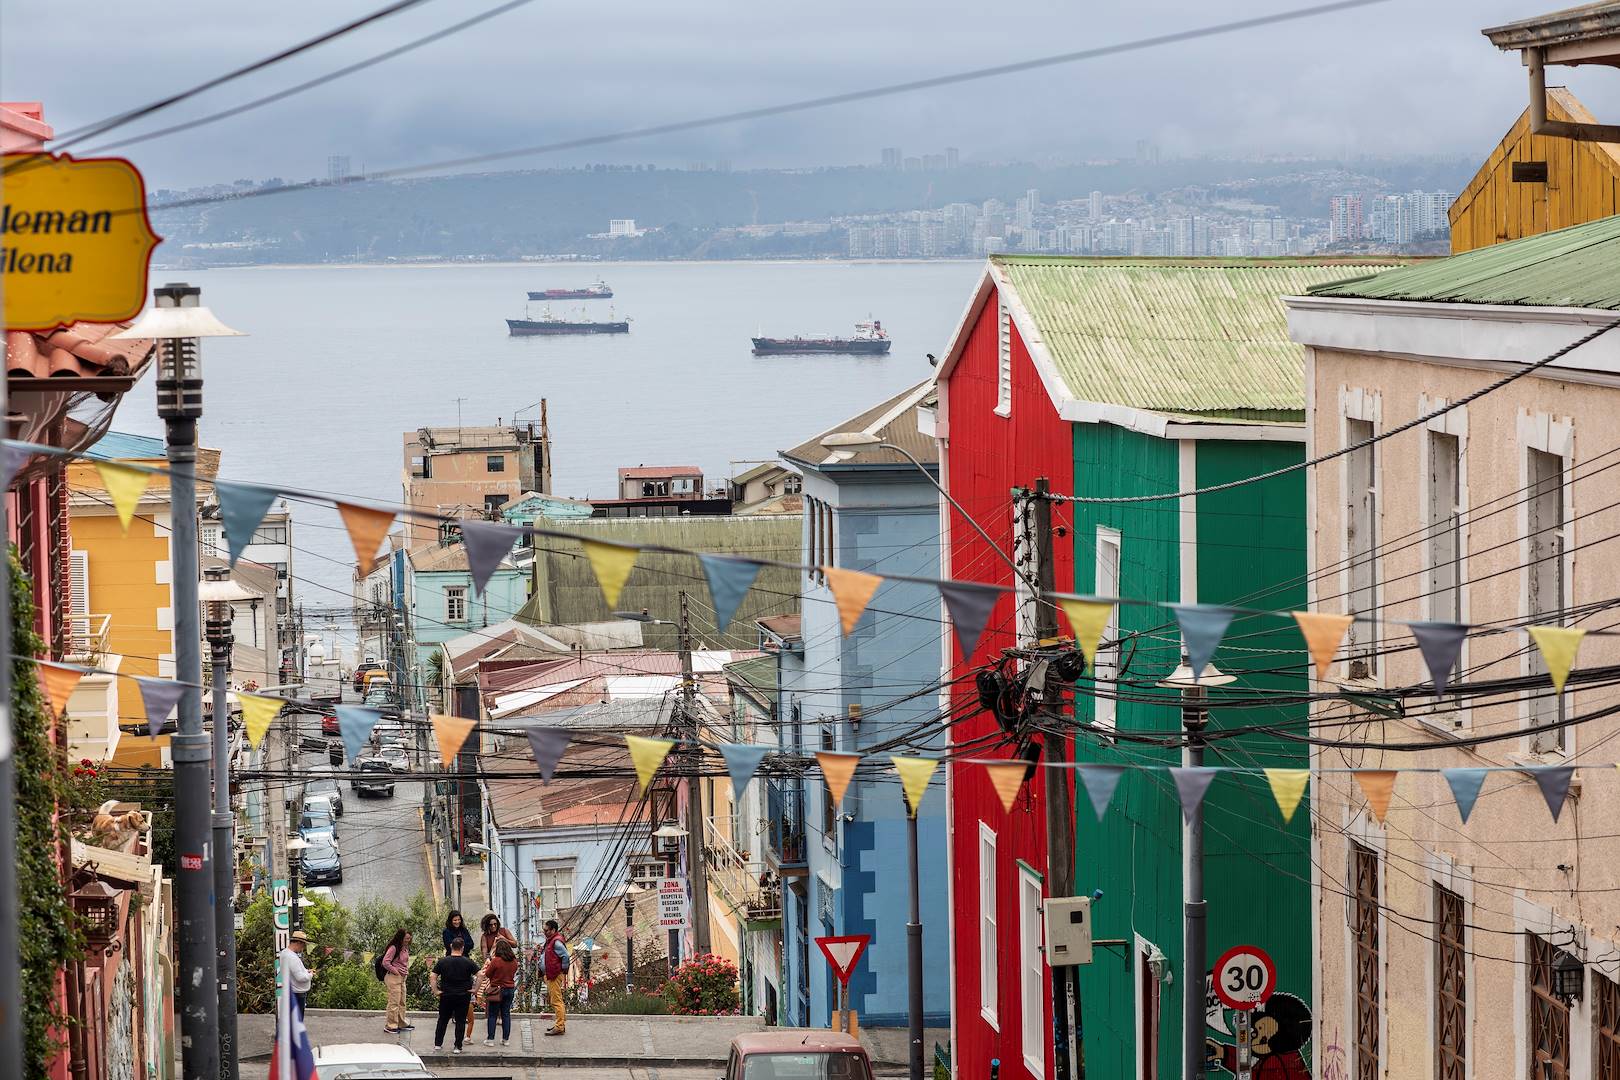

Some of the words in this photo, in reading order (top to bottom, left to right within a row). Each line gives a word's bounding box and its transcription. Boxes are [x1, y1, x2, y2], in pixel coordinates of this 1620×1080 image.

[0, 204, 112, 235] leman
[0, 248, 73, 274] ilena
[1227, 964, 1263, 992] 30
